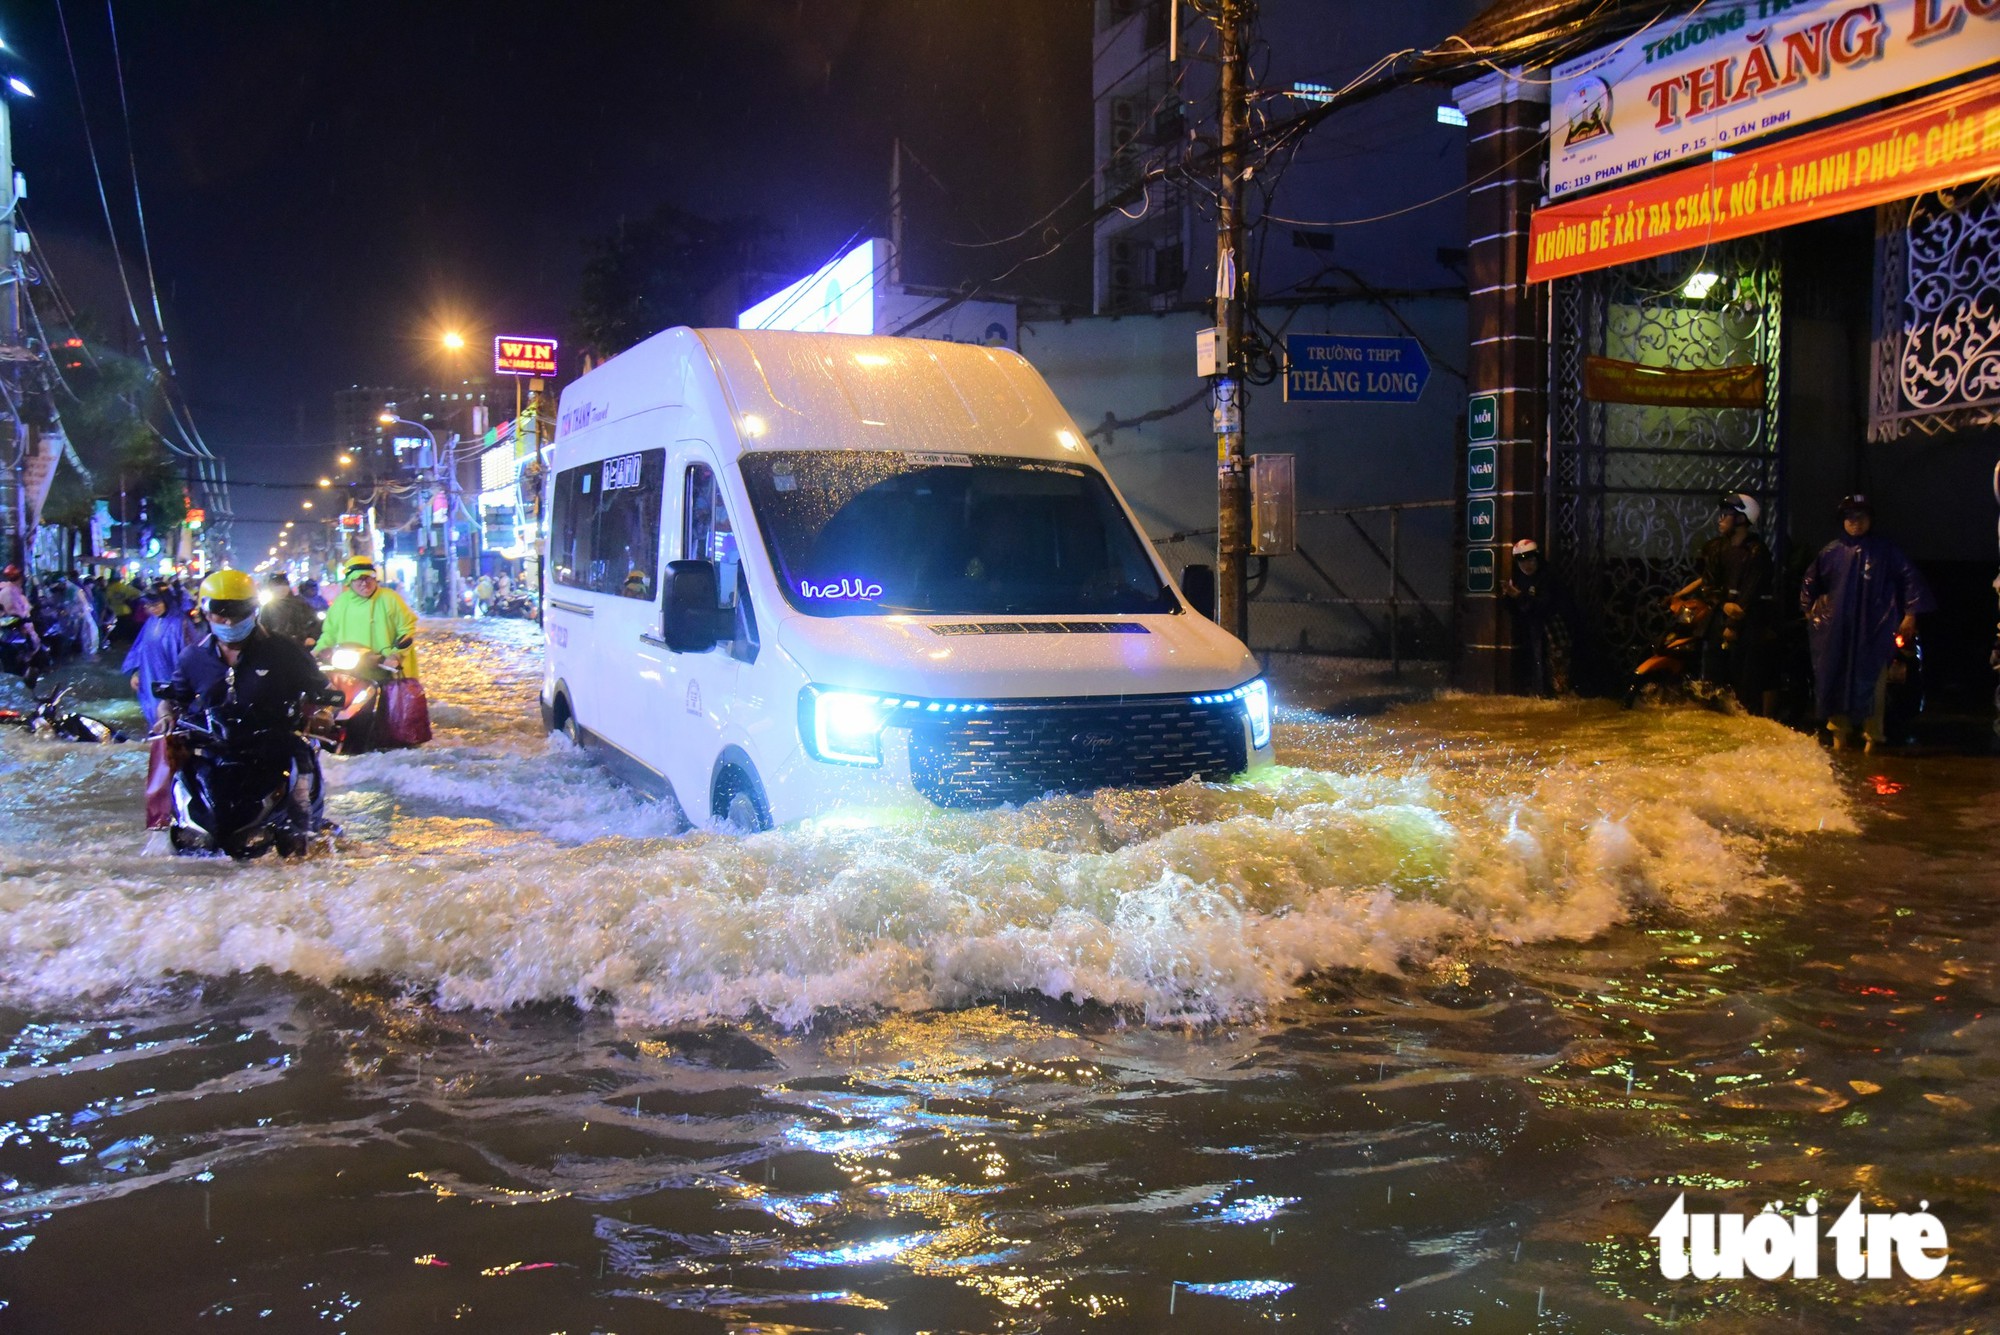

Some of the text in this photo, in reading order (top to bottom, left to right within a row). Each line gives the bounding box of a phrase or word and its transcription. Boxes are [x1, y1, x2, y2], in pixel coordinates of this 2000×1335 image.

[1648, 6, 1881, 128] THĂNG
[1574, 174, 1591, 188] 119
[1595, 164, 1623, 181] PHAN
[1627, 156, 1648, 171] HUY
[1653, 148, 1671, 163] ÍCH
[1535, 221, 1587, 264] KHÔNG
[1589, 203, 1612, 252] ĐỂ
[1613, 200, 1645, 246] XẢY
[1648, 201, 1671, 237] RA
[1674, 182, 1726, 231] CHÁY,
[1730, 162, 1758, 218] NỔ
[1761, 162, 1786, 210] LÀ
[1790, 151, 1851, 208] HẠNH
[1854, 128, 1919, 186] PHÚC
[1924, 106, 1975, 167] CỦA
[501, 342, 552, 360] WIN
[1307, 344, 1401, 362] TRƯỜNG THPT
[1290, 365, 1418, 393] THĂNG LONG
[1471, 461, 1493, 474] NGÀY
[801, 578, 882, 598] hello
